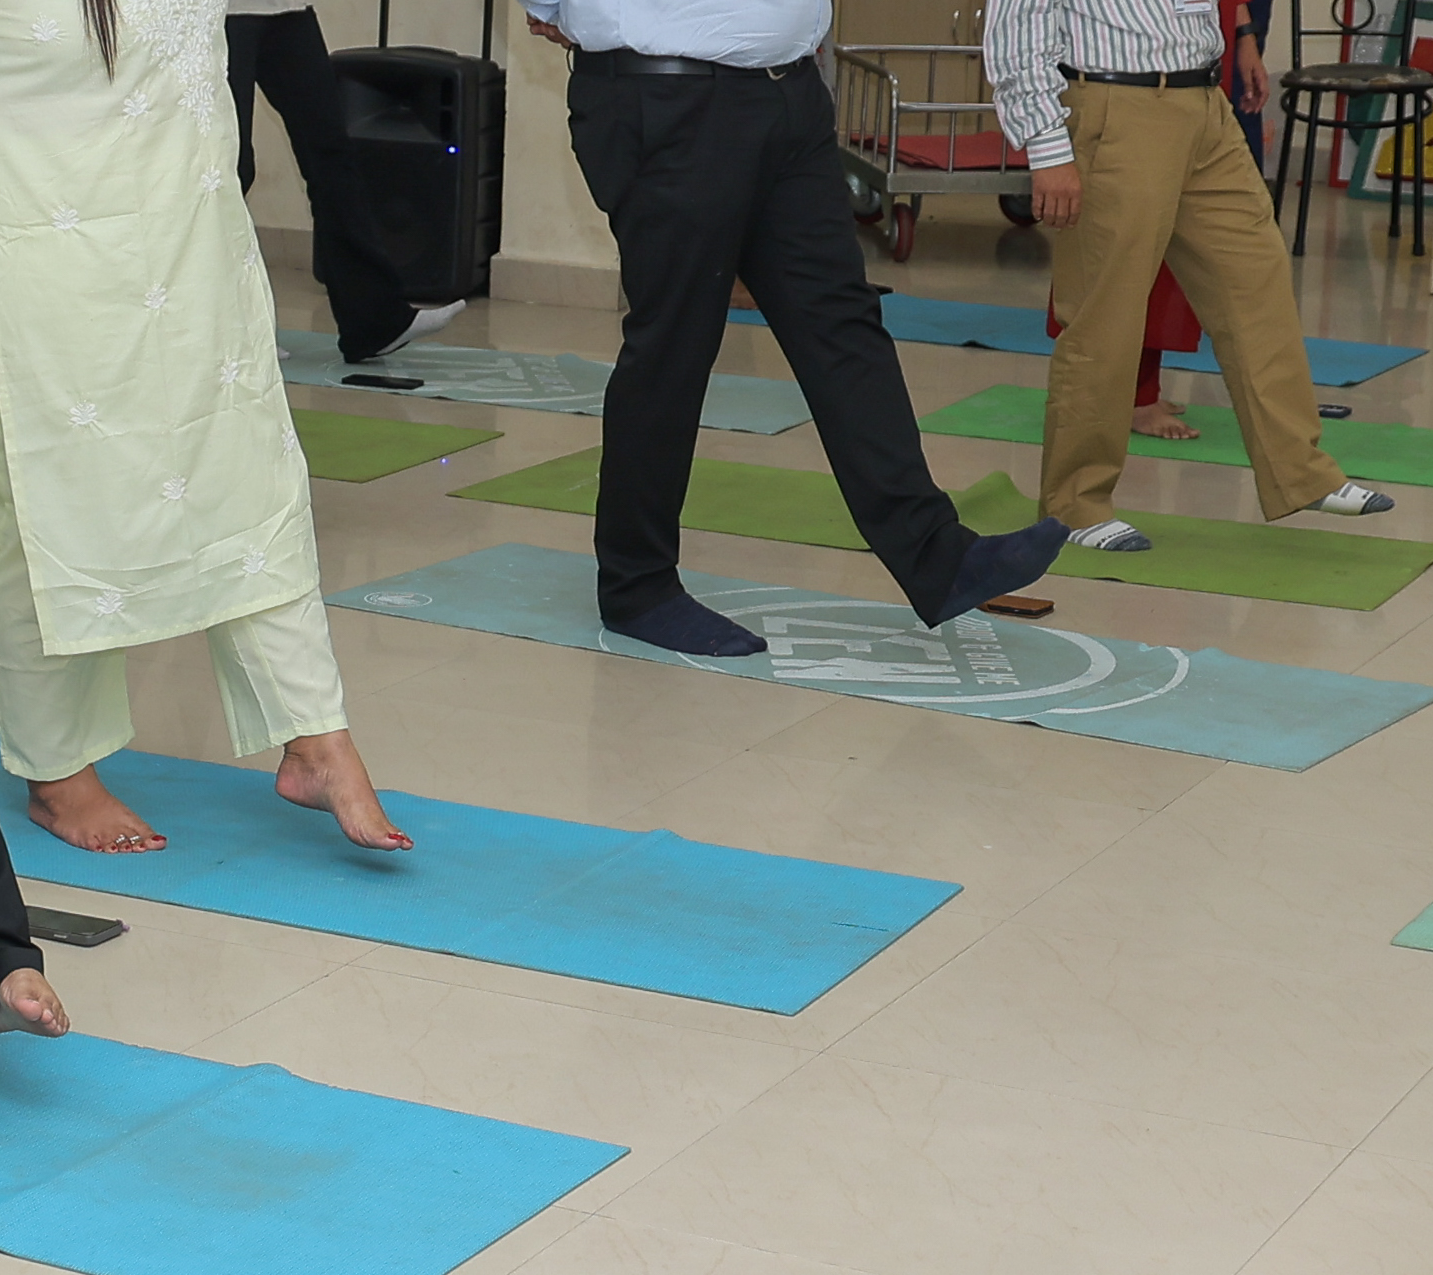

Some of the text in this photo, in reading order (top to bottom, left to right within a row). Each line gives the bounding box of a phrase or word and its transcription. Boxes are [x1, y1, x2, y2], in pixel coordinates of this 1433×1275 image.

[762, 615, 962, 685] ZEN
[965, 652, 1014, 672] GIVE
[974, 672, 1021, 686] ME
